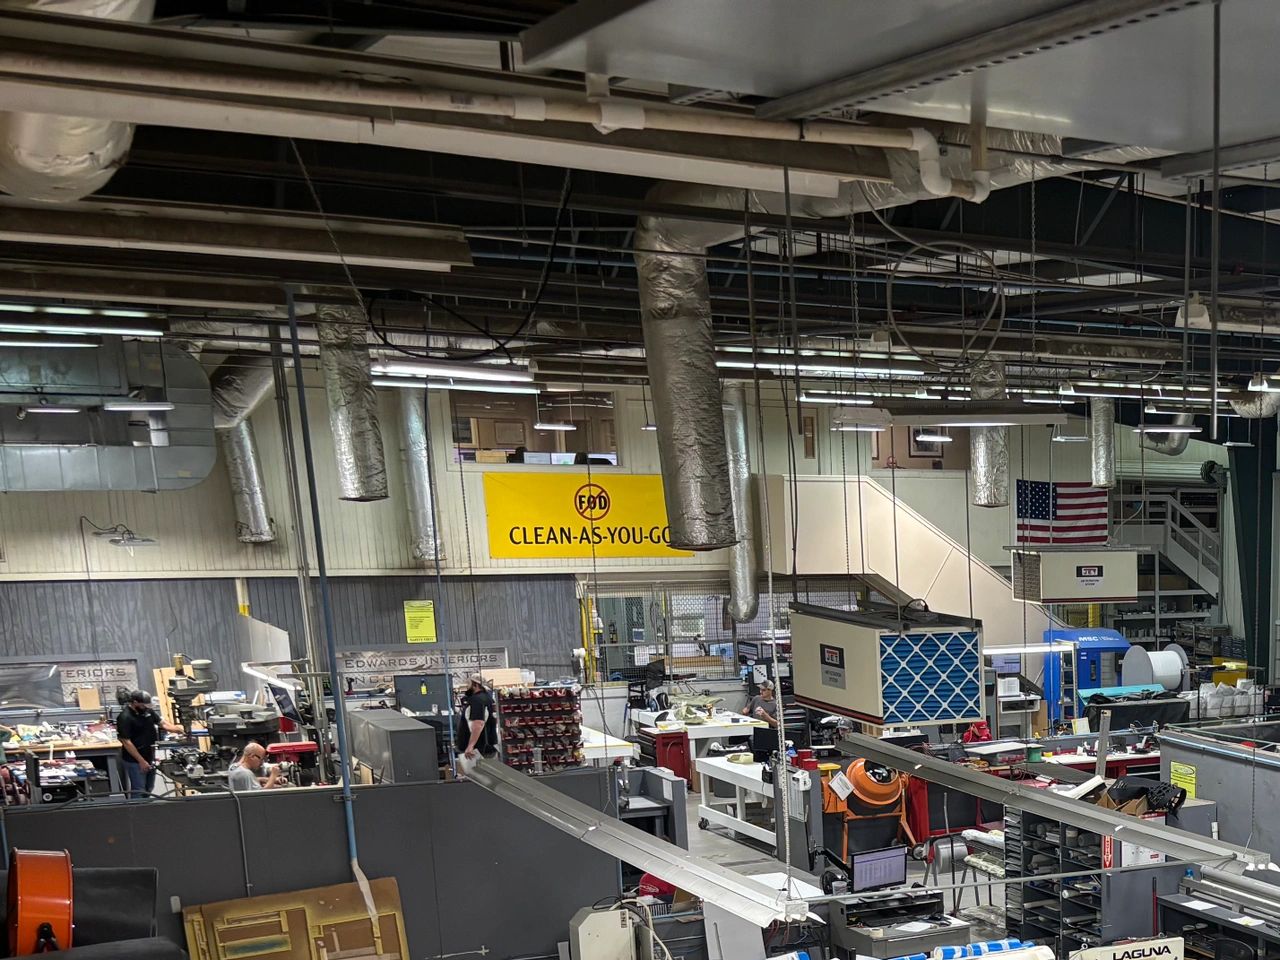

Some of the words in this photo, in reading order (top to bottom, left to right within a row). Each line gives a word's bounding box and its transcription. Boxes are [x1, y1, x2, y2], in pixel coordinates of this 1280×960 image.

[509, 526, 672, 545] CLEAN-AS-YOU-GO
[345, 657, 418, 670] EDWARDS
[424, 653, 498, 666] INTERIORS
